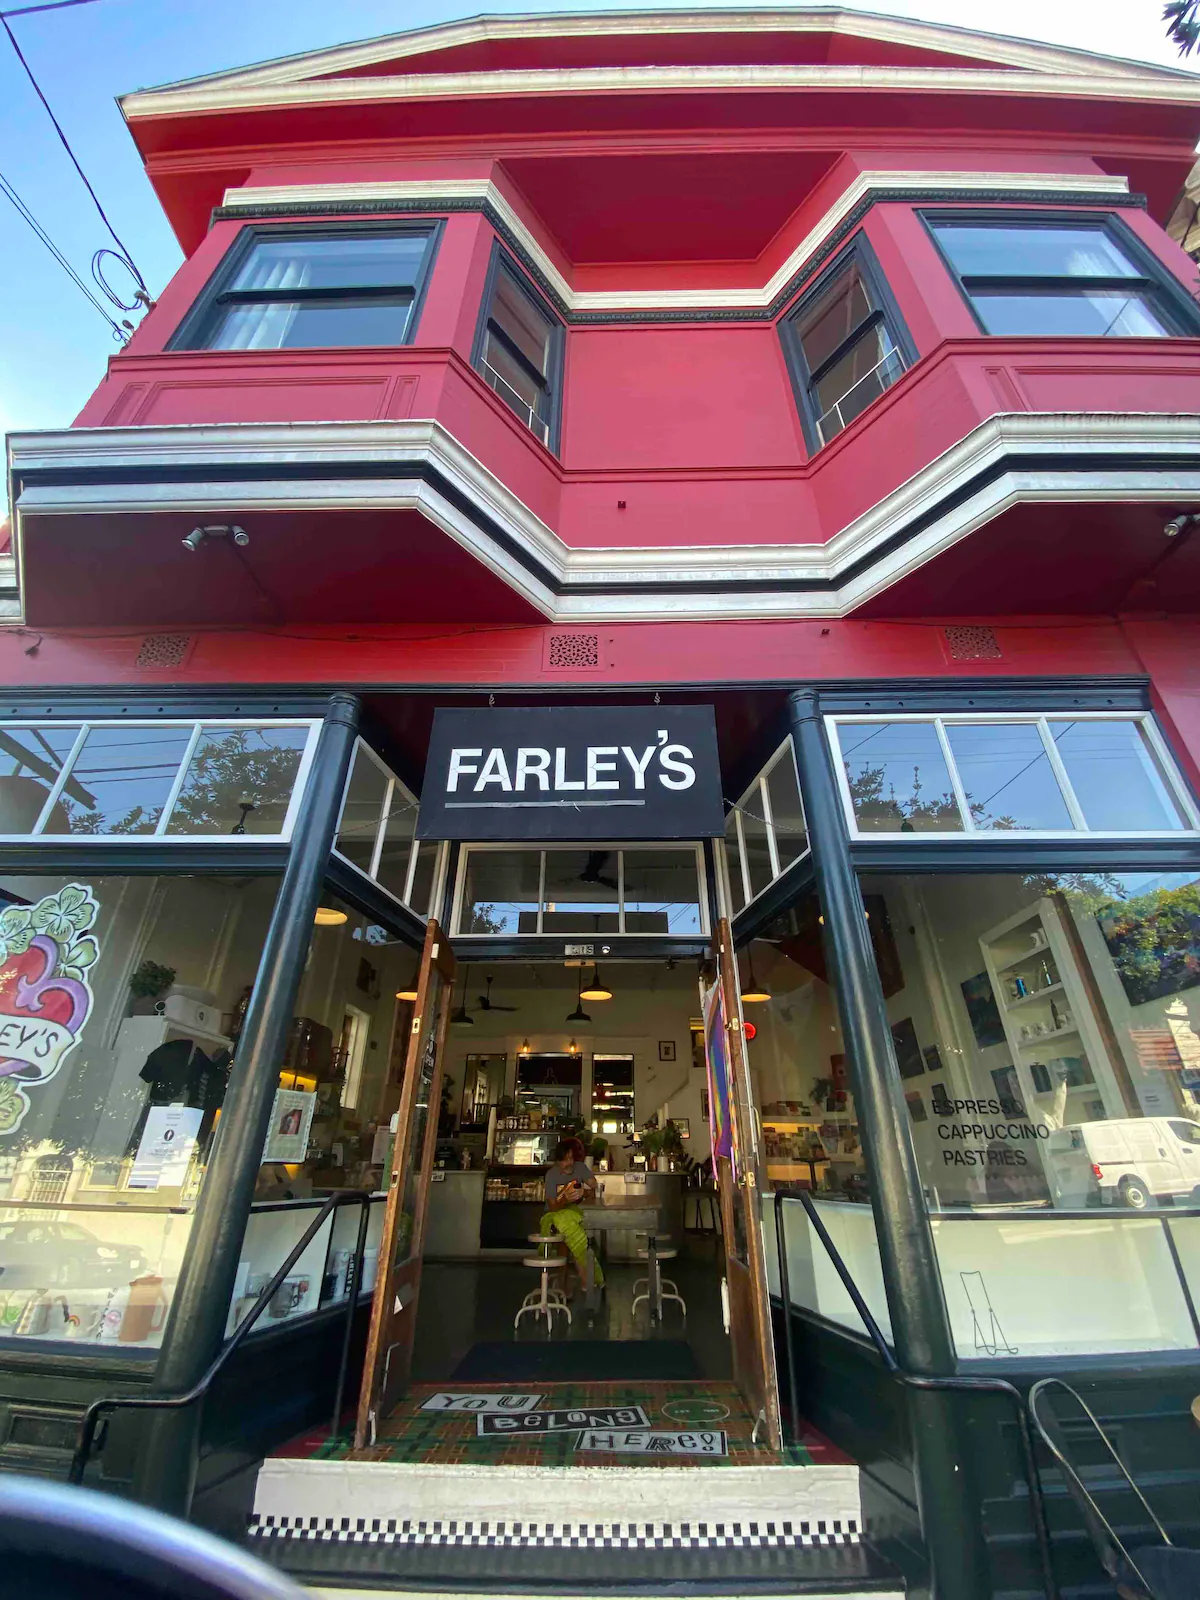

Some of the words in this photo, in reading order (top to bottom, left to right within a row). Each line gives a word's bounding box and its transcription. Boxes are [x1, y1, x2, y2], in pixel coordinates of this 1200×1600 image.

[446, 729, 697, 792] FARLEY'S
[932, 1099, 1026, 1115] ESPRESSO
[937, 1123, 1050, 1140] CAPPUCCINO
[943, 1150, 1028, 1166] PASTRIES
